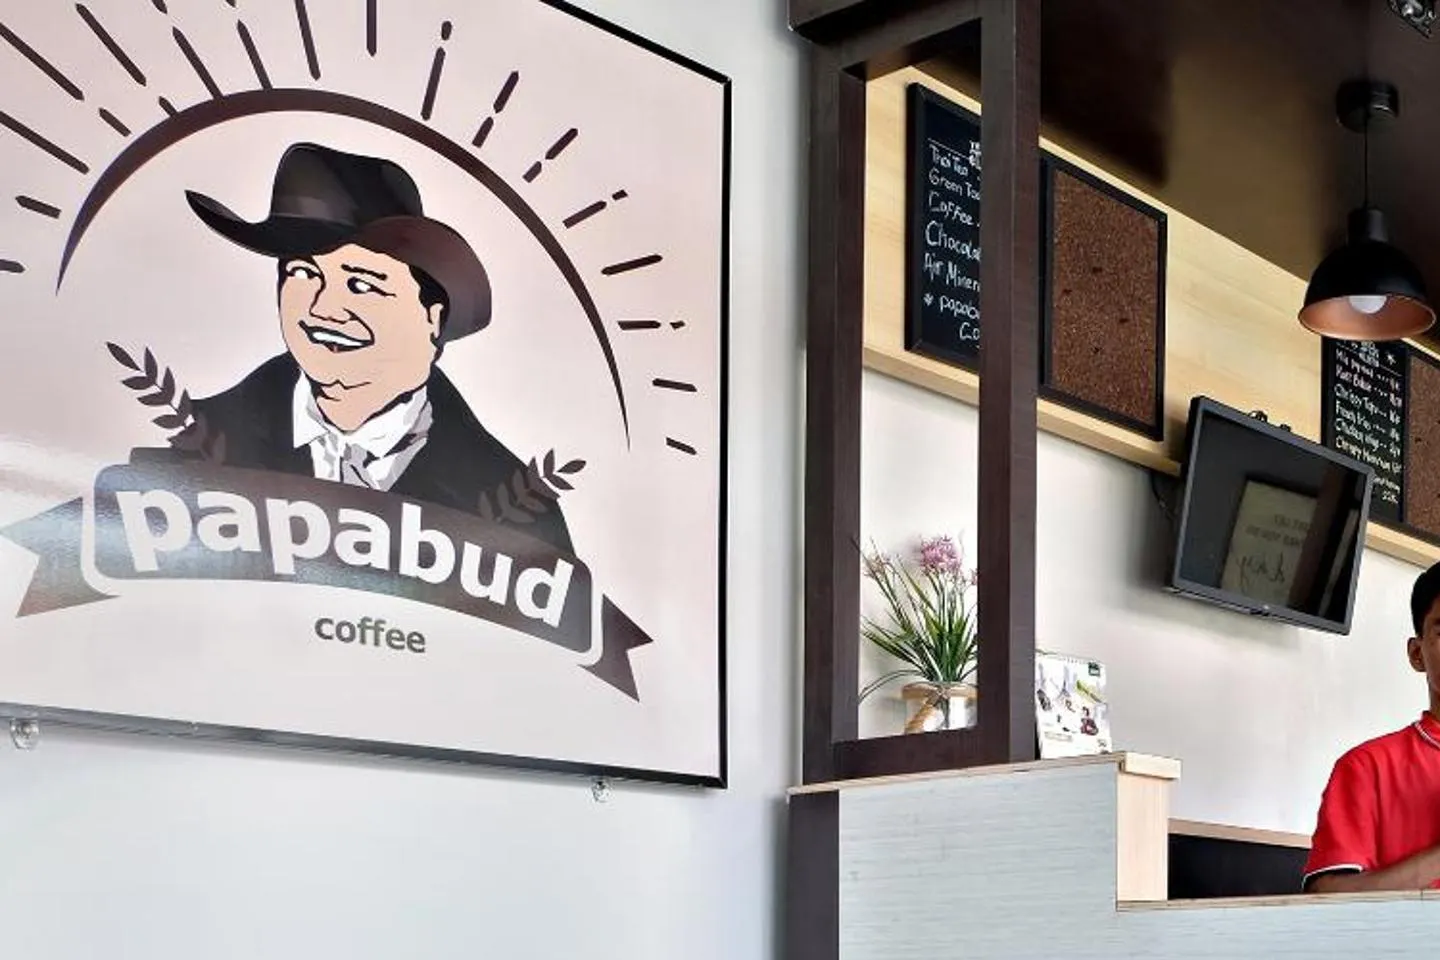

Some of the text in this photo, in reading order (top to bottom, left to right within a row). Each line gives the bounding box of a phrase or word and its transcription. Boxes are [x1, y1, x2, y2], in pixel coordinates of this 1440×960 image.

[928, 168, 963, 197] Green
[928, 190, 974, 226] Coffee
[946, 261, 981, 293] Miner
[116, 487, 574, 627] papabud
[314, 613, 426, 654] coffee
